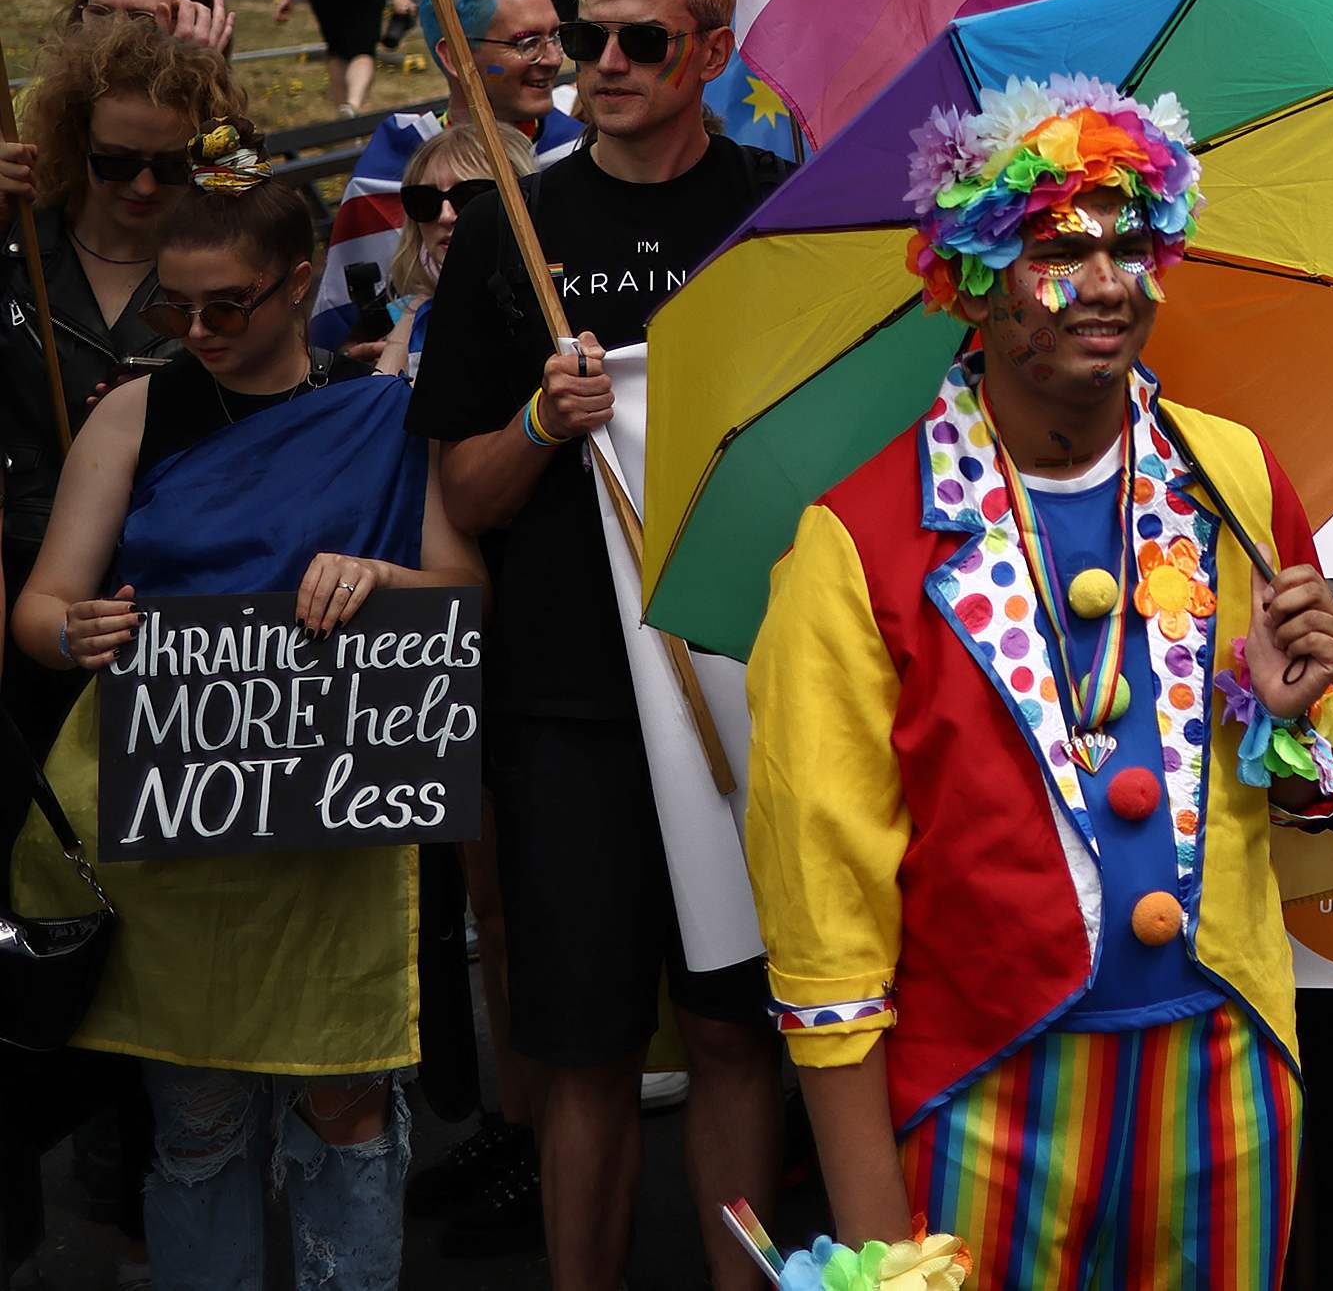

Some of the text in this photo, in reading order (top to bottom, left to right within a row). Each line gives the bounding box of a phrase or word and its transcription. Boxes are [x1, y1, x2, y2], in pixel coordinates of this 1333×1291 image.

[637, 241, 659, 253] I'M
[563, 270, 686, 298] KRAIN
[336, 599, 481, 670] needs
[127, 672, 477, 758] MORE help
[1062, 733, 1118, 758] PROUD
[120, 753, 446, 843] NOT less
